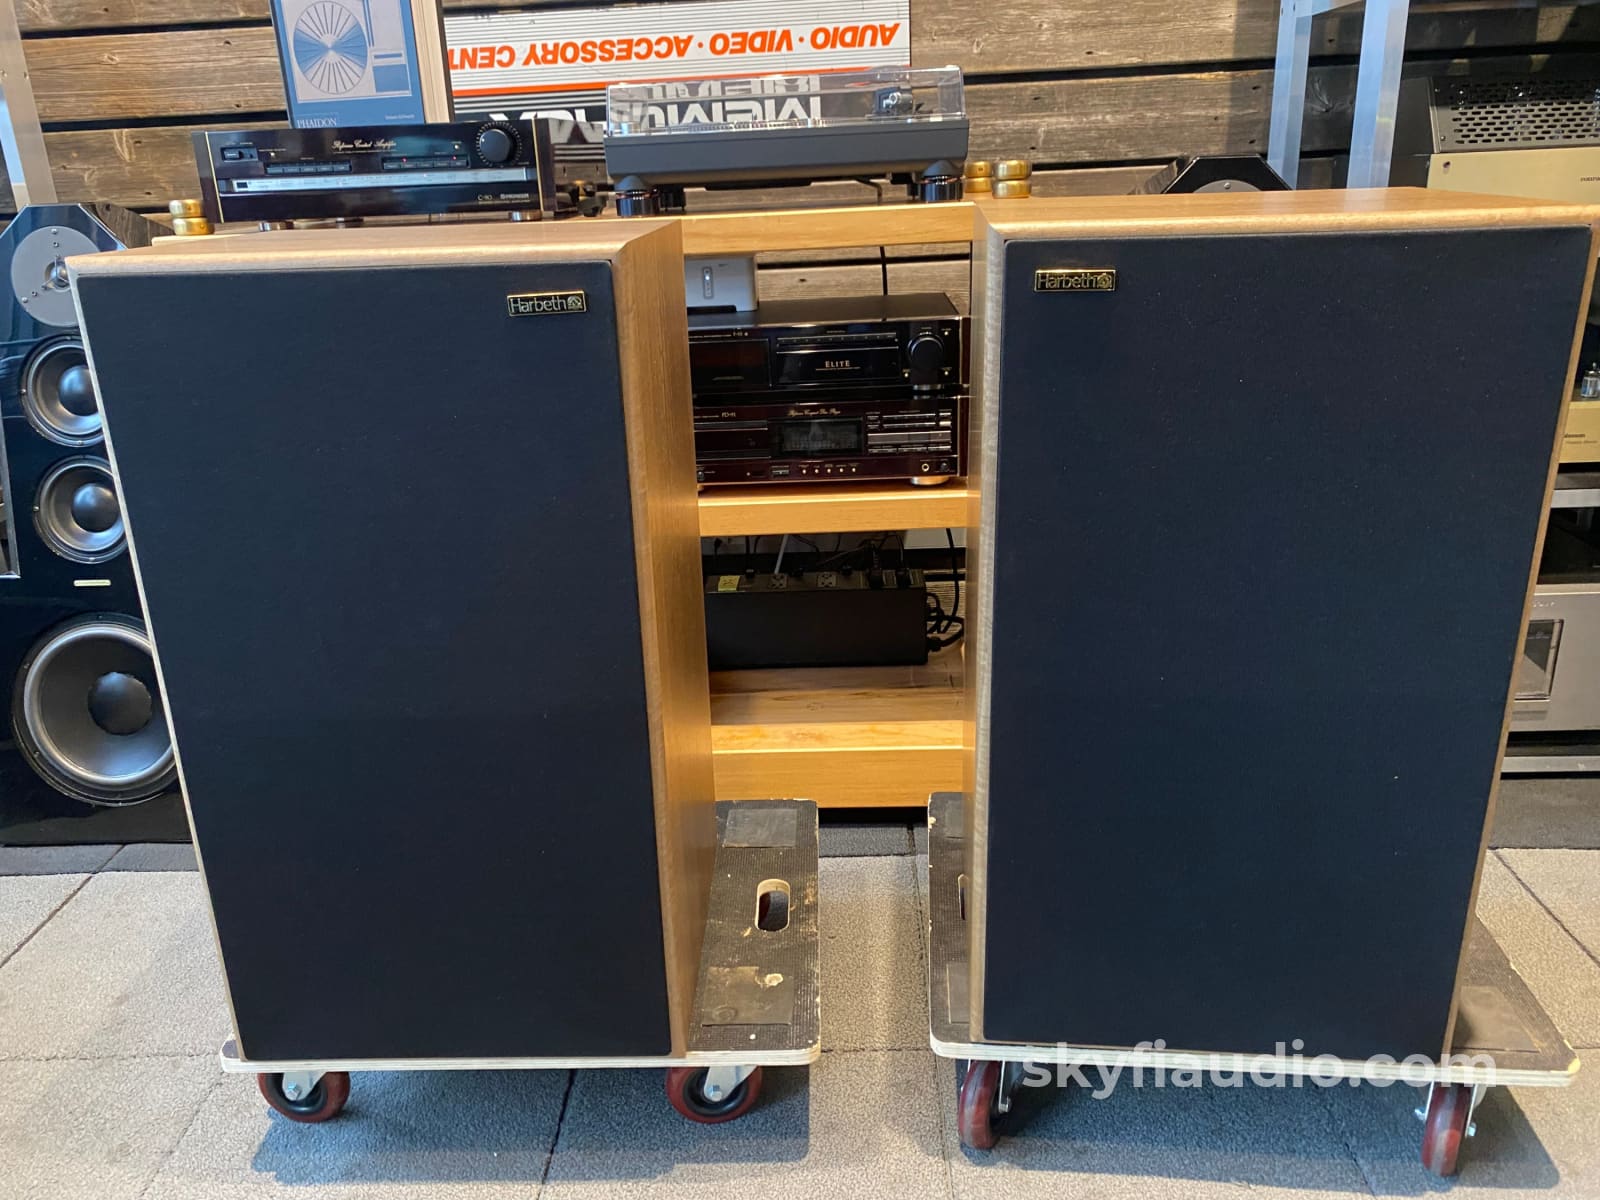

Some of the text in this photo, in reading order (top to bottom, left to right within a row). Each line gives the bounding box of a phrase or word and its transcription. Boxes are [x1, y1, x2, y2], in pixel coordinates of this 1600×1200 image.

[709, 28, 794, 56] VIDEO
[809, 23, 901, 50] AUDIO
[522, 34, 694, 67] ACCESSORY
[296, 118, 338, 129] PHAIDON
[1037, 272, 1097, 289] Harbeth
[509, 295, 567, 313] Harbeth
[825, 360, 850, 368] ELITE
